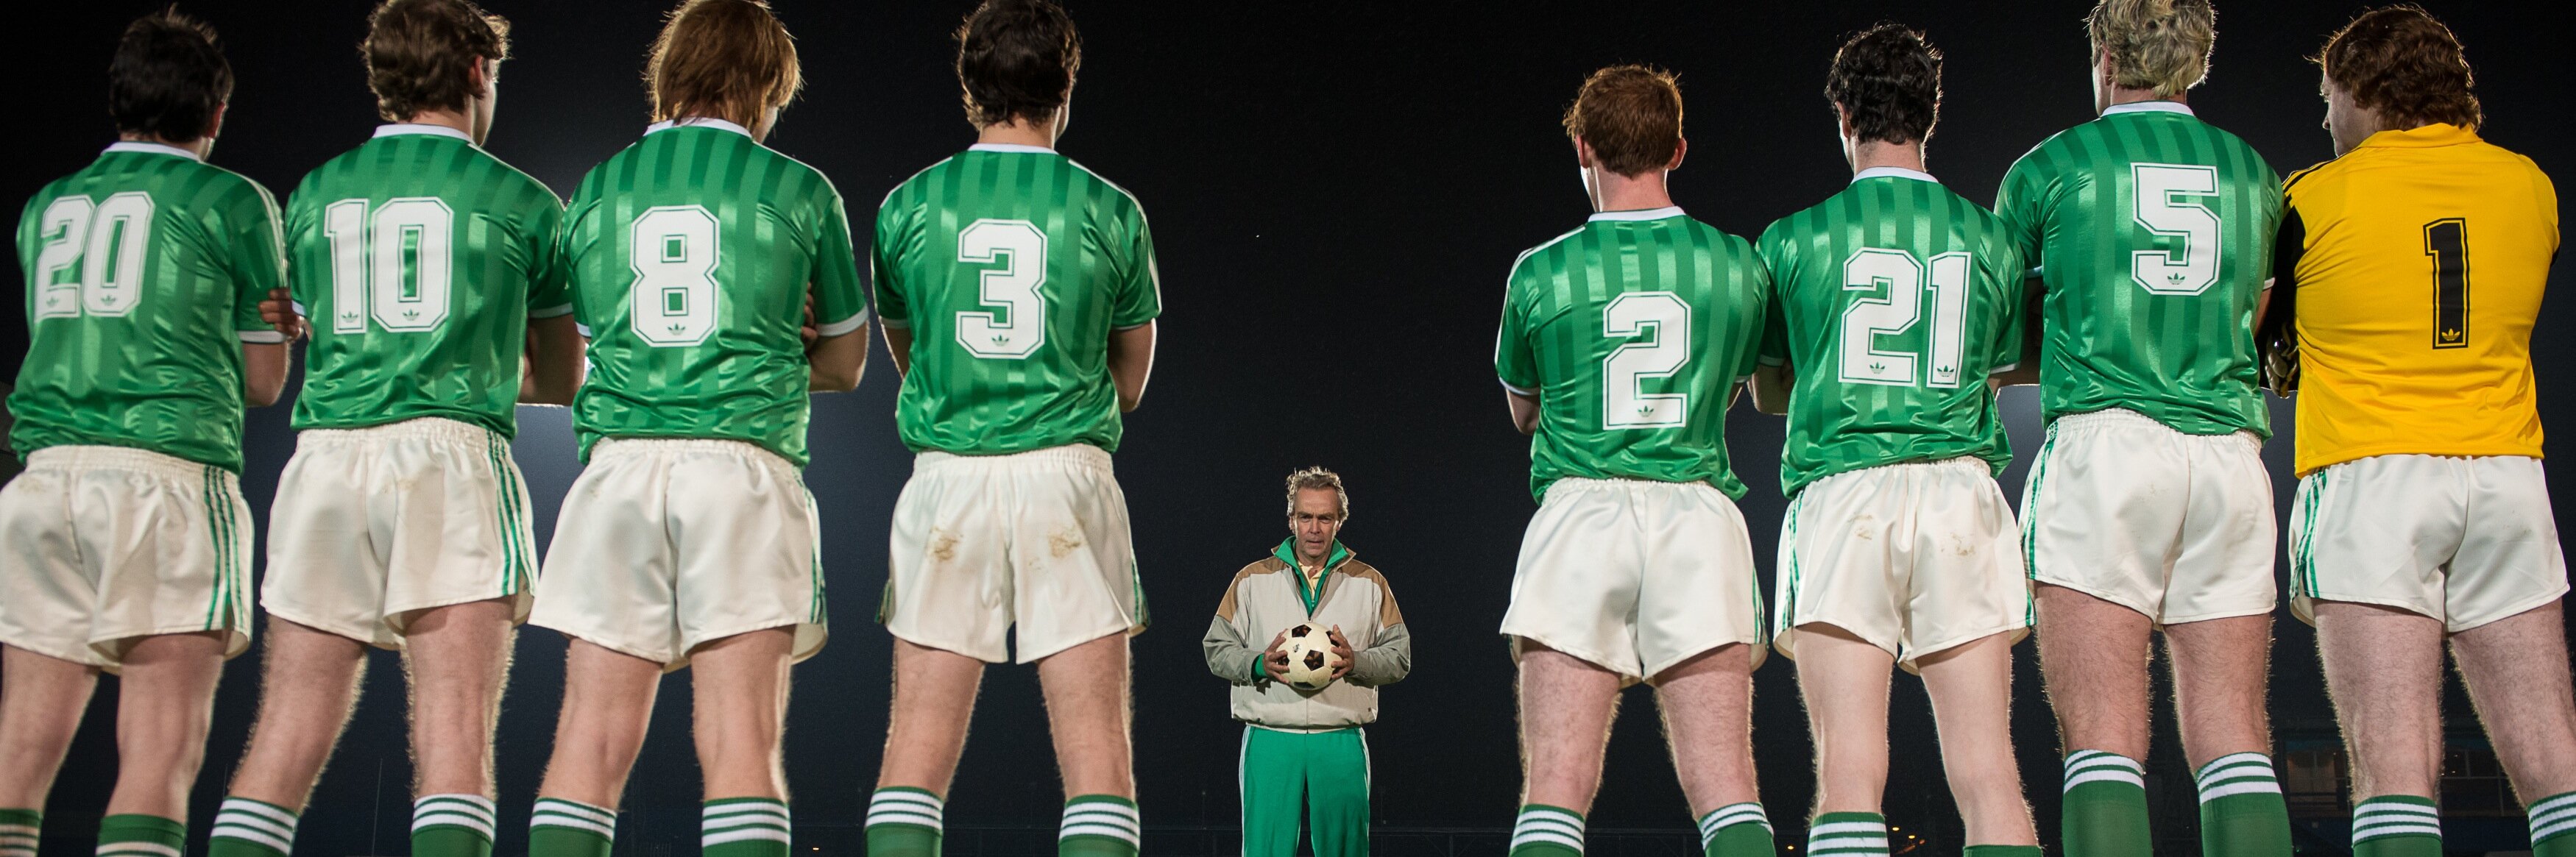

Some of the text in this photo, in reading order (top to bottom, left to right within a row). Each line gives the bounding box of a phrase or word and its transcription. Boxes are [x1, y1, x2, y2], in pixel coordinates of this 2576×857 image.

[35, 191, 155, 322] 20
[324, 197, 453, 334] 10
[629, 204, 721, 347] 8
[956, 218, 1047, 359] 3
[2131, 163, 2221, 296] 5
[2424, 218, 2470, 349] 1
[1603, 291, 1691, 430] 2
[1839, 246, 1971, 388] 21
